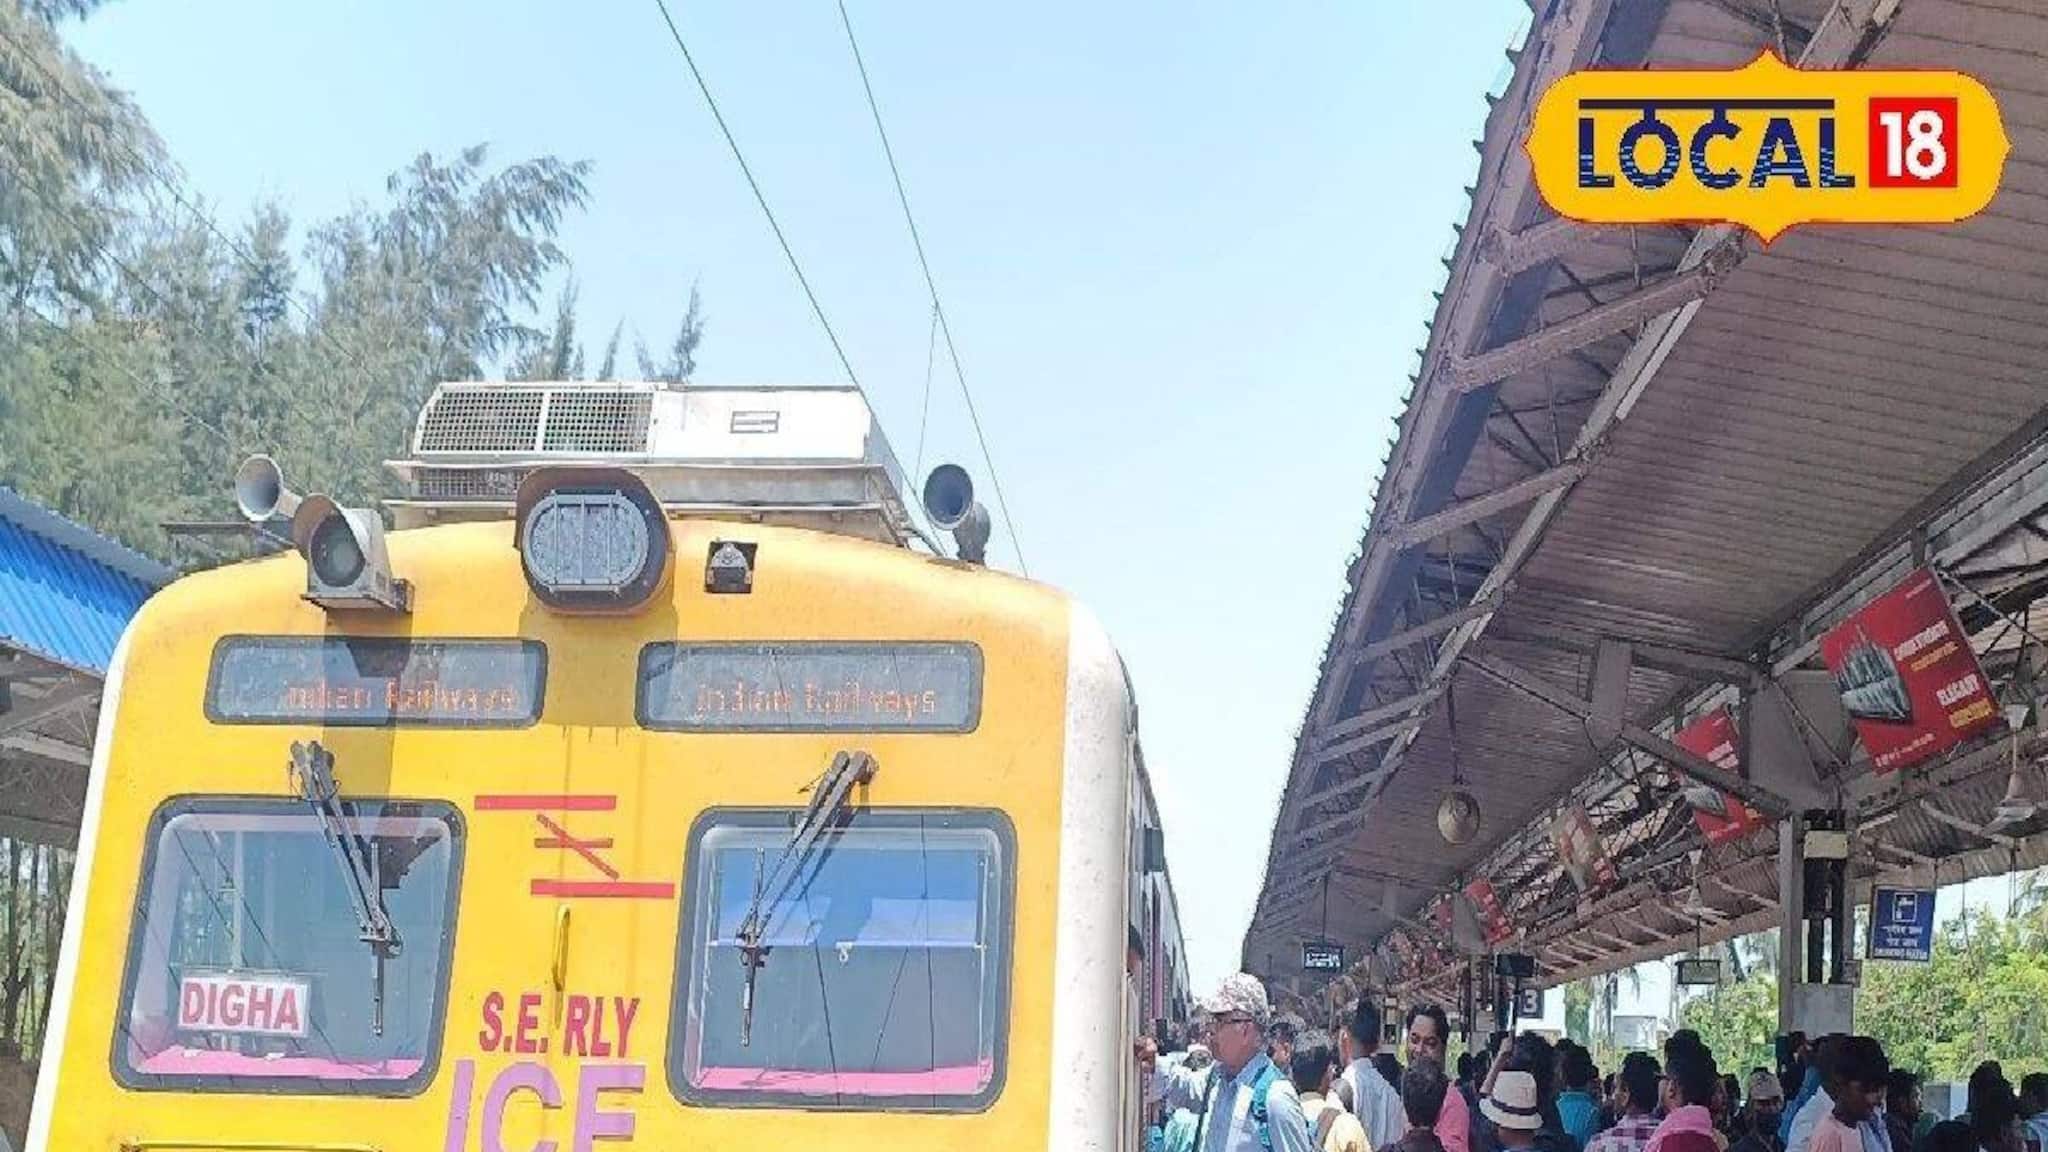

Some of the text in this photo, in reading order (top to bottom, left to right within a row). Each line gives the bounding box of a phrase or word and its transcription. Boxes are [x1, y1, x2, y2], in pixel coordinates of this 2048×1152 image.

[181, 981, 300, 1031] DIGHA
[479, 991, 640, 1058] S.E. RLY
[1523, 989, 1537, 1013] 3
[444, 1059, 646, 1152] ICF
